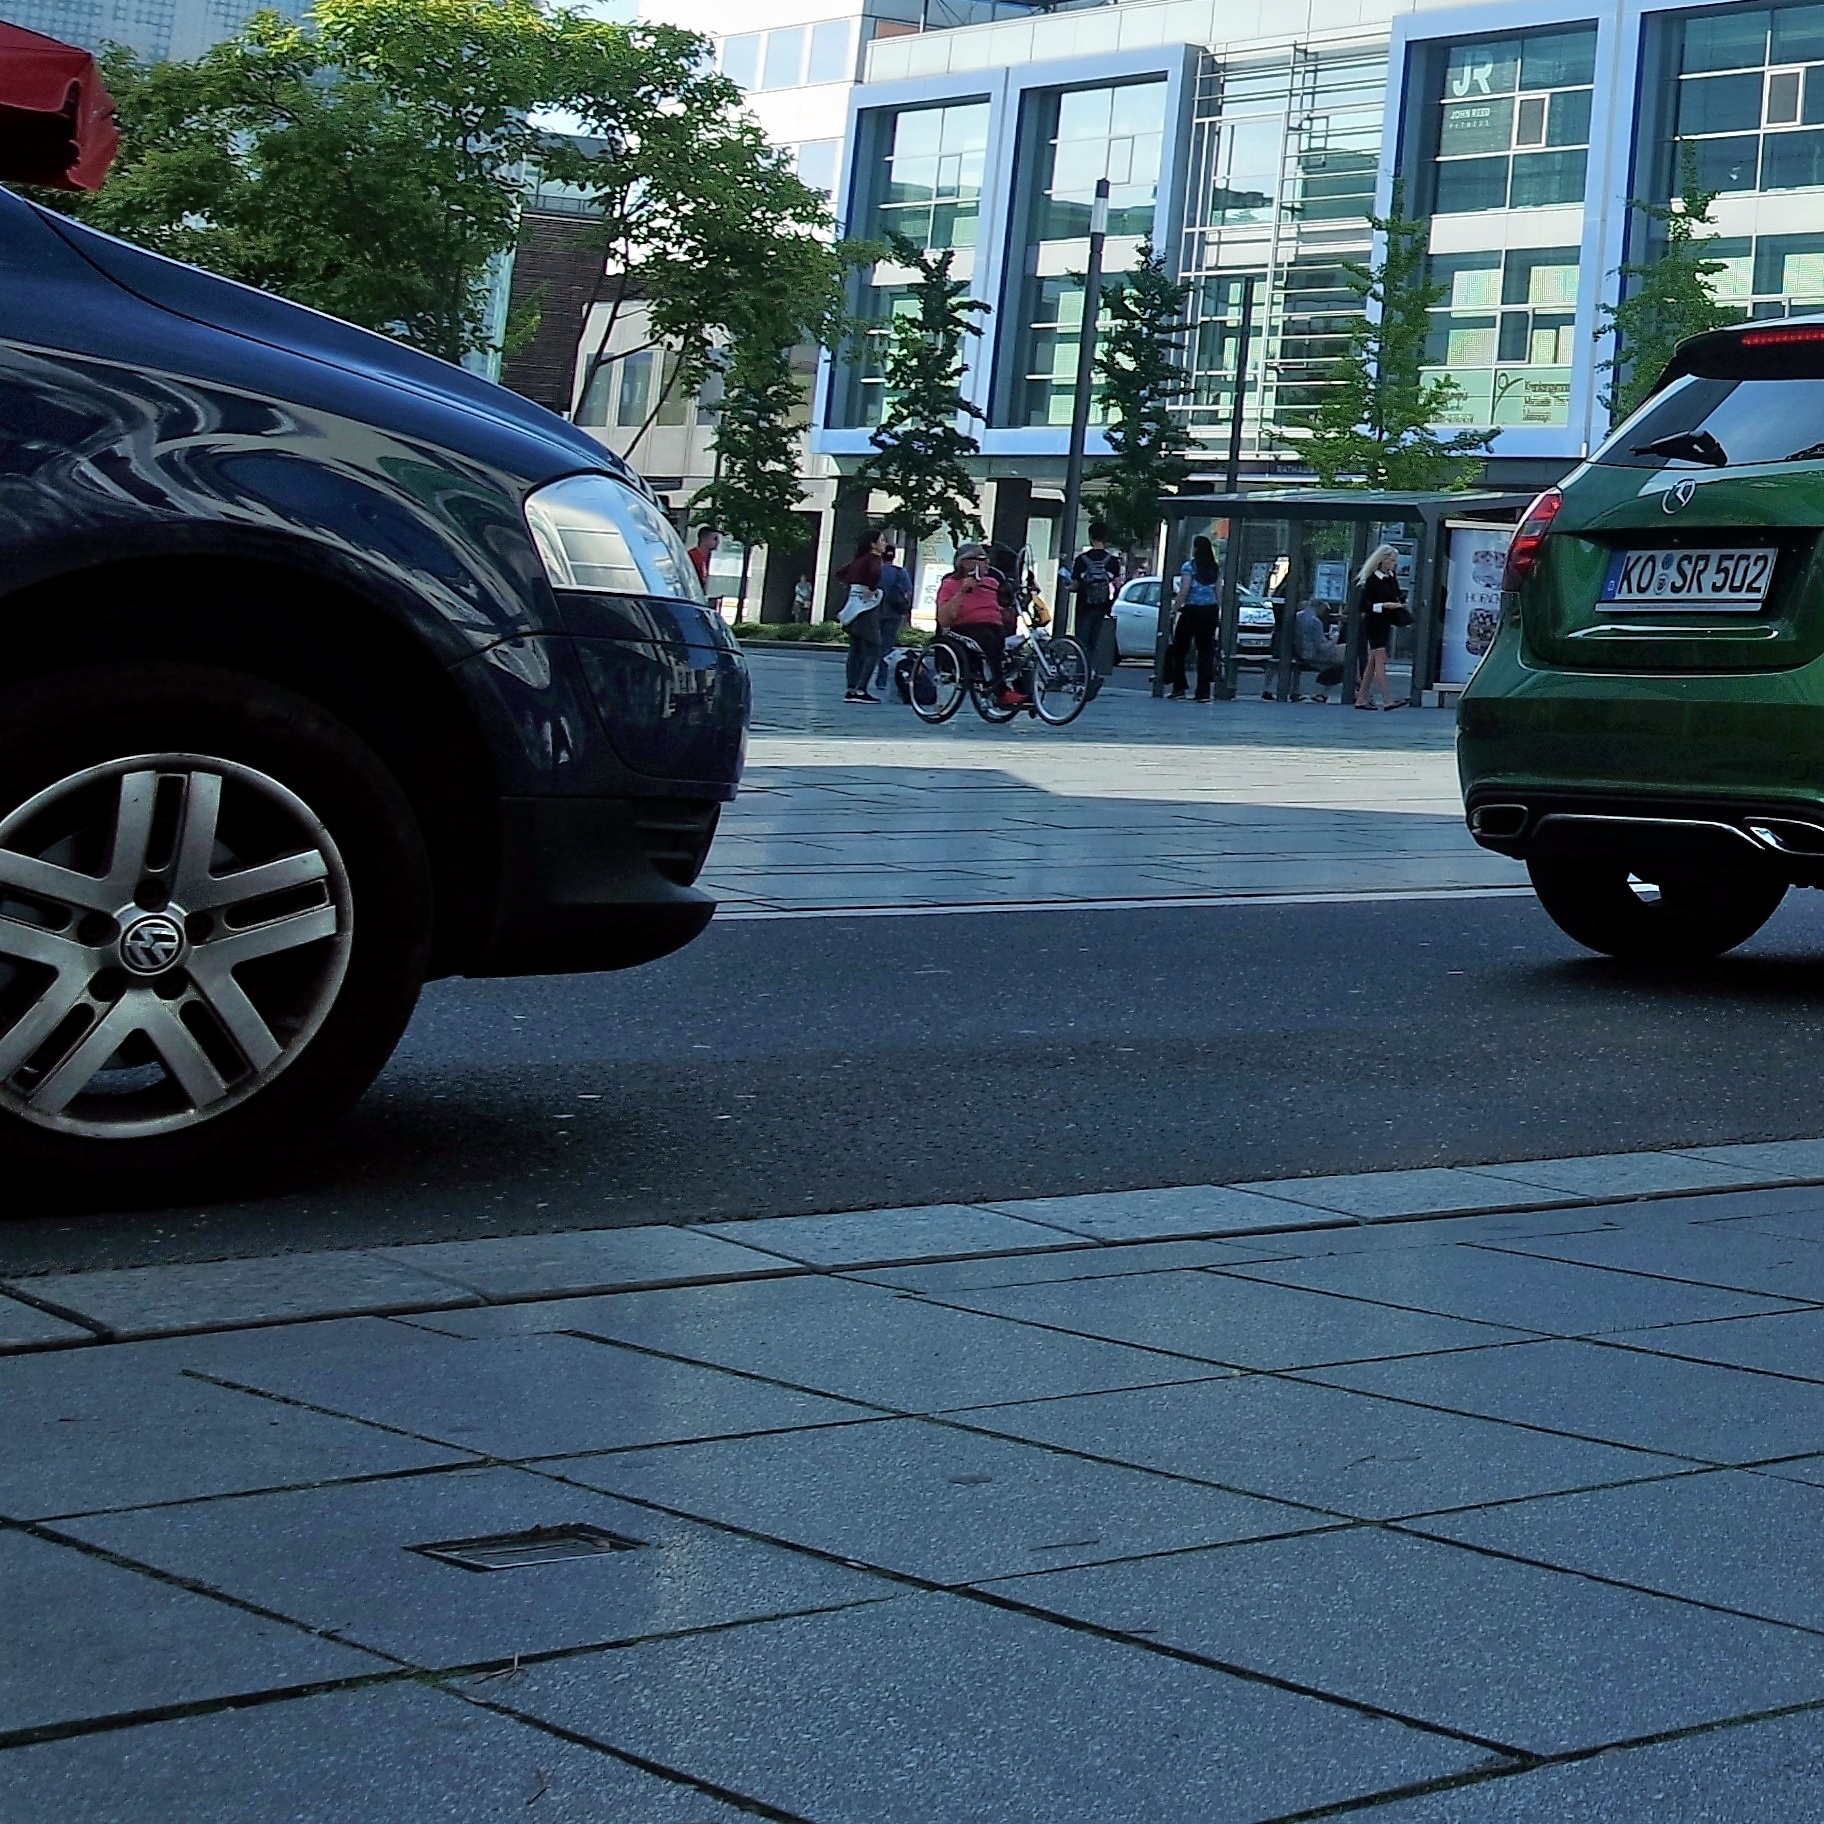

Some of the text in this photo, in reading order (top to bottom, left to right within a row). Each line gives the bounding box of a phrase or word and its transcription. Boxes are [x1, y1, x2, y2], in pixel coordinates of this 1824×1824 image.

[1617, 554, 1656, 594] KO
[1670, 553, 1710, 594] SR
[1711, 553, 1769, 594] 502
